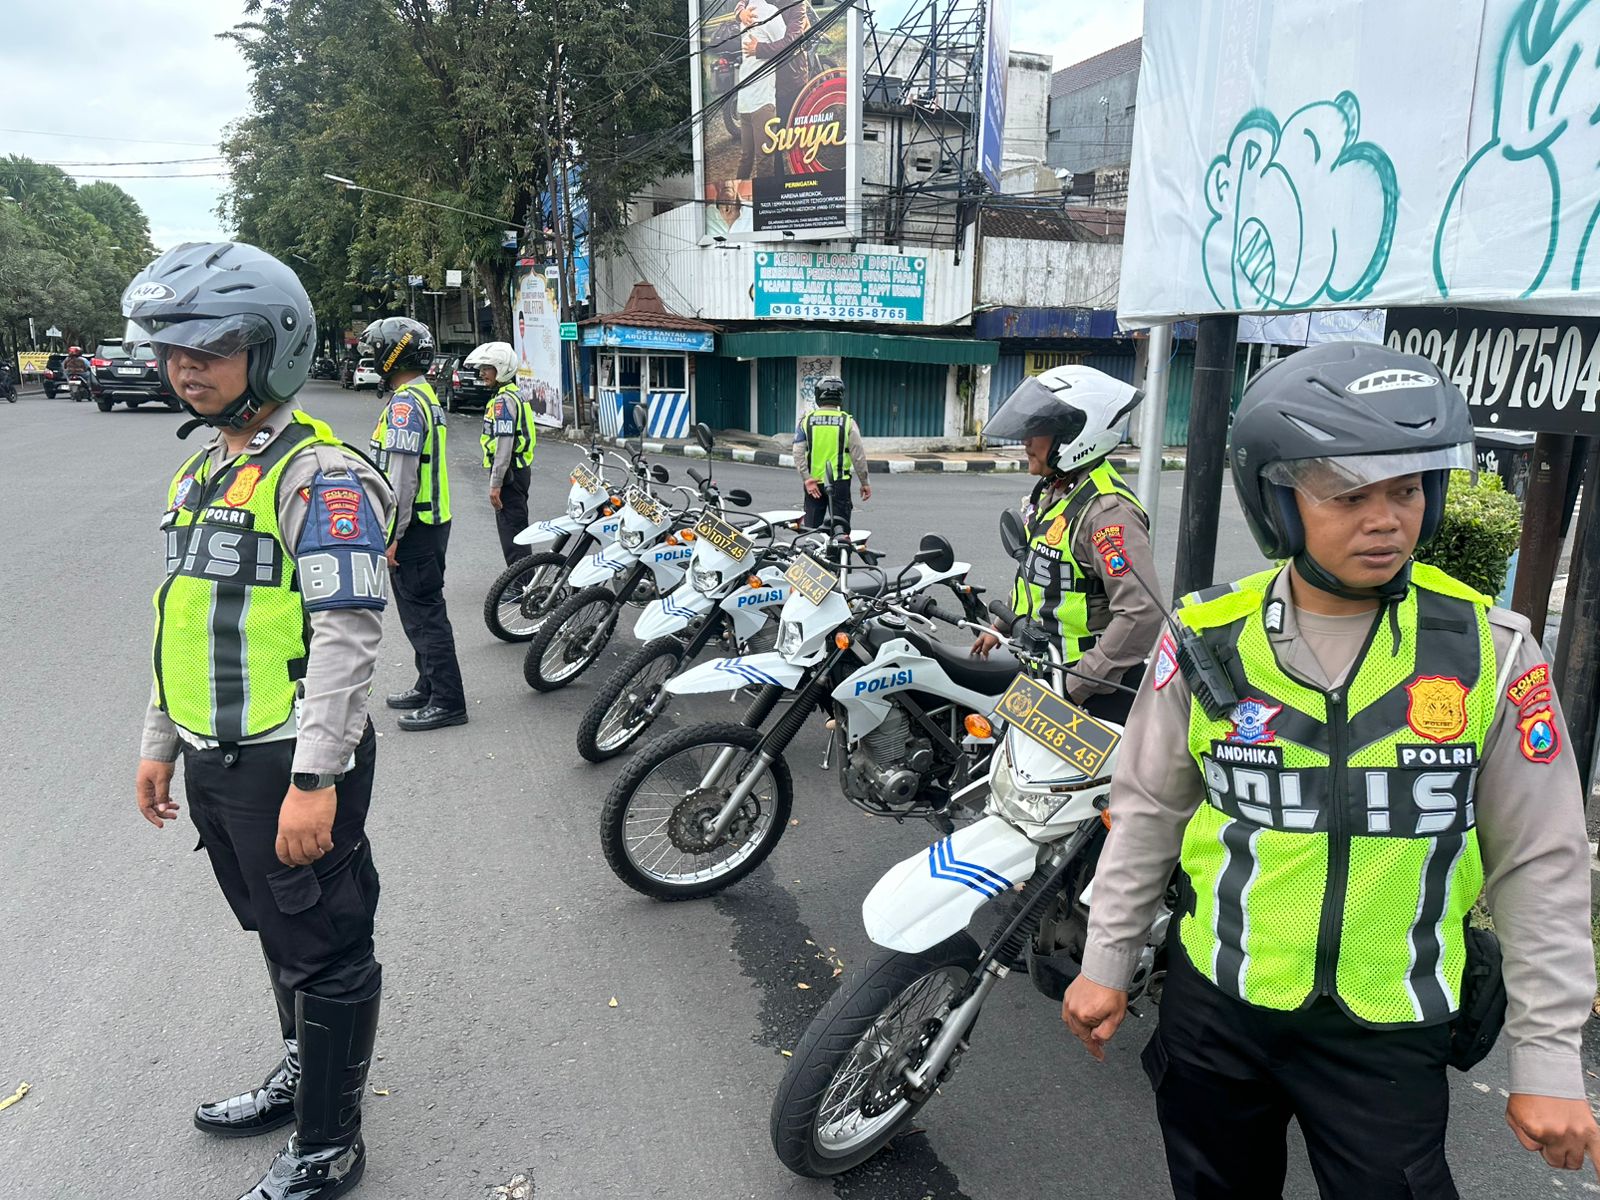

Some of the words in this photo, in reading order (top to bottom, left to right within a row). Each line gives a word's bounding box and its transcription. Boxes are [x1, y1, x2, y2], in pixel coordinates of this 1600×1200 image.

[794, 116, 808, 126] KITA
[809, 112, 834, 123] ADALAH
[761, 117, 847, 164] Surya
[774, 253, 813, 267] KEDIRI
[816, 254, 865, 269] FLORIST
[868, 256, 911, 271] DIGITAL
[785, 306, 905, 319] 0813-3265-8765
[1387, 326, 1600, 412] 14197504
[1358, 374, 1425, 390] INK
[810, 416, 844, 426] POLISI
[1073, 444, 1096, 462] HRV
[206, 508, 246, 523] POLRI
[729, 531, 738, 540] X
[710, 531, 744, 558] 1017-45
[1037, 543, 1060, 559] POLRI
[655, 548, 693, 562] POLIS
[816, 572, 824, 581] X
[738, 590, 783, 608] POLISI
[855, 670, 913, 696] POLISI
[1509, 667, 1546, 697] POLRES
[1065, 714, 1084, 733] X
[1216, 744, 1278, 765] ANDHIKA
[1403, 748, 1472, 765] POLRI
